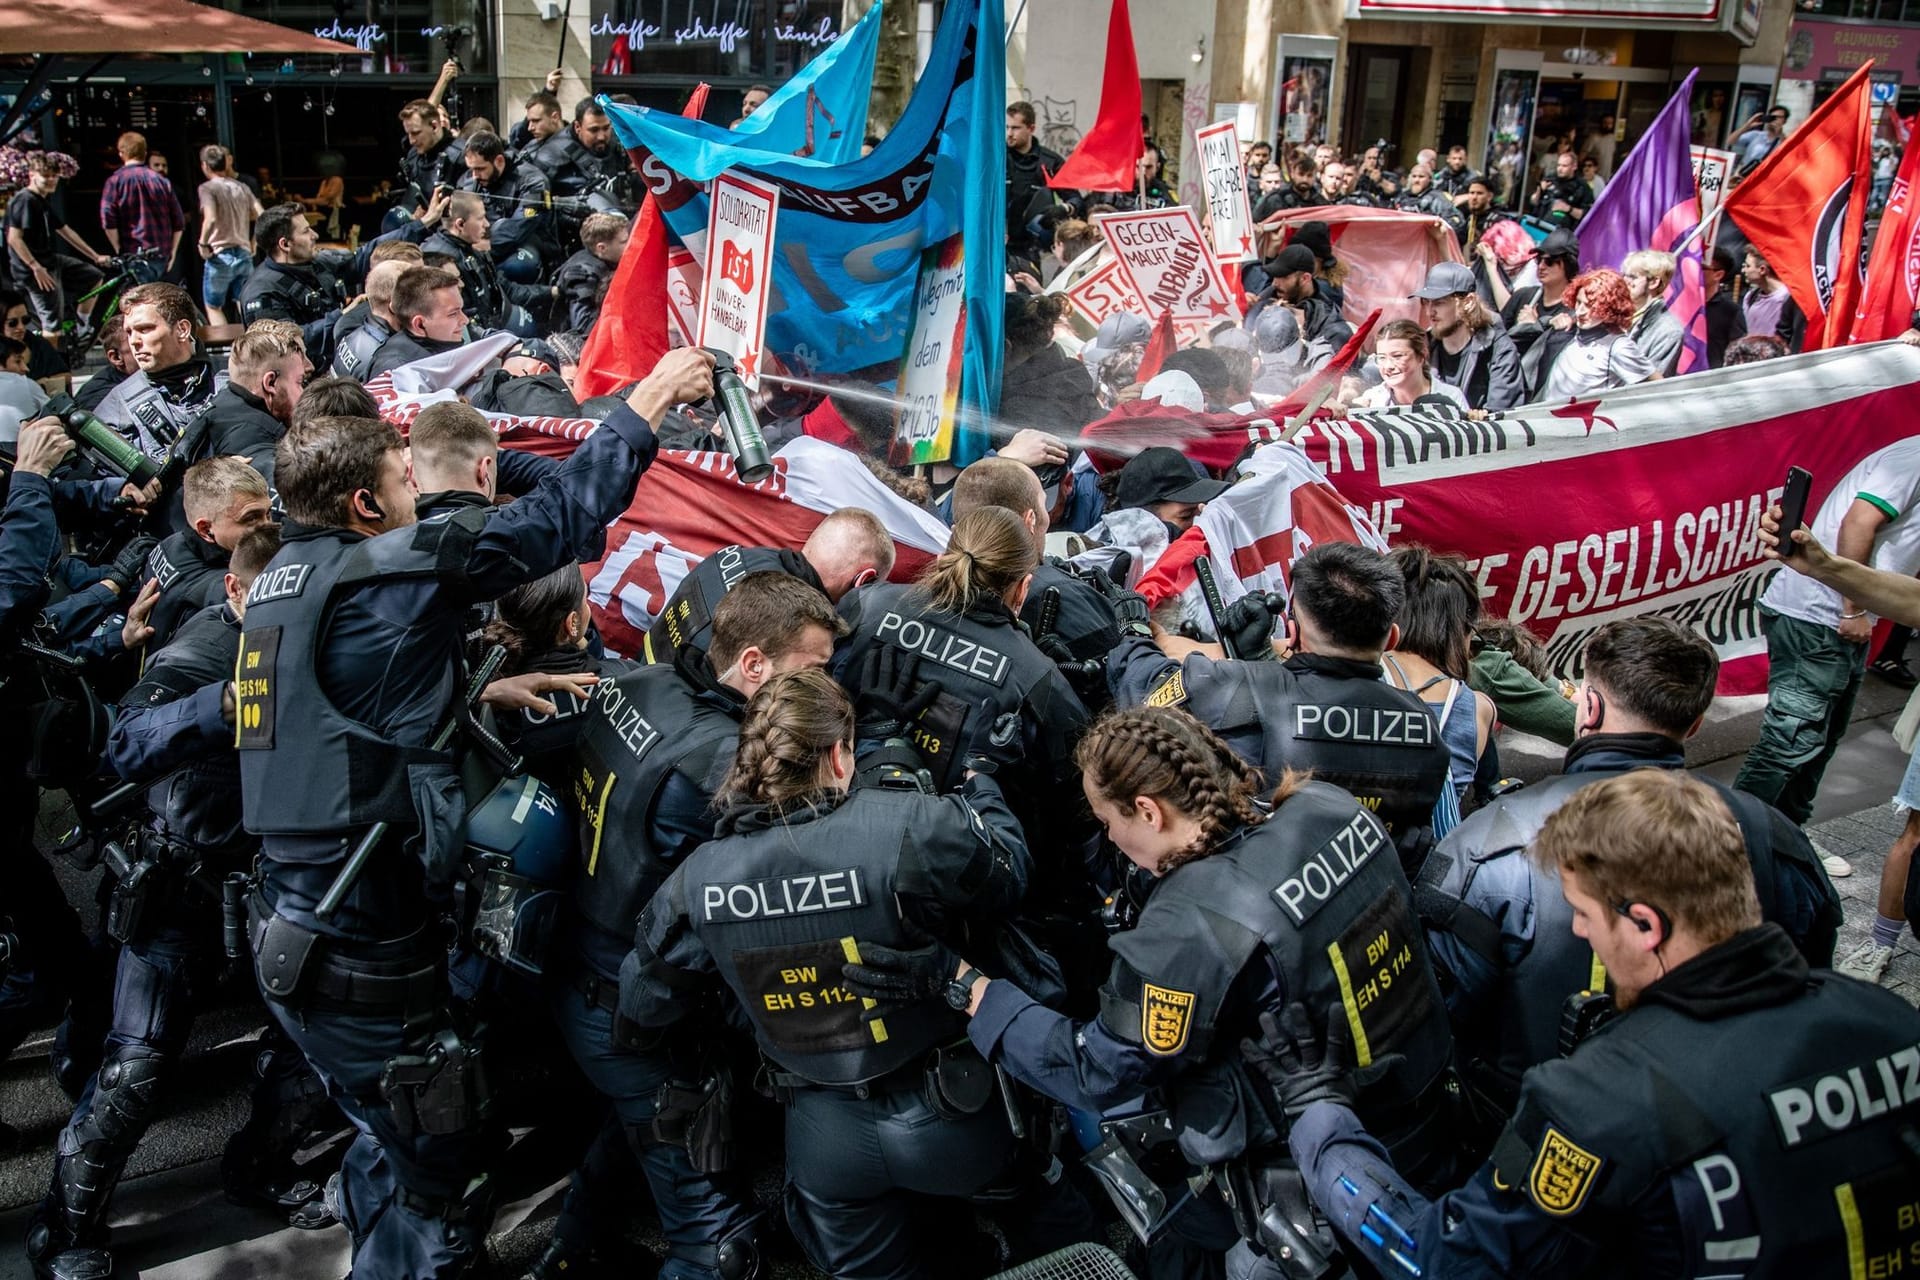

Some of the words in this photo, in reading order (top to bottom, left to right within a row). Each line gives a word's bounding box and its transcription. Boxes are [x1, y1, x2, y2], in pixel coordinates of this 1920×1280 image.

[674, 17, 749, 53] schaffe
[1115, 221, 1180, 247] GEGEN-
[1124, 246, 1173, 269] MACHT
[1148, 236, 1200, 314] AUFBAUEN
[914, 328, 941, 368] dem
[1509, 486, 1784, 625] GESELLSCHAF
[247, 563, 309, 603] POLIZEI
[875, 611, 1008, 682] POLIZEI
[596, 677, 657, 756] POLIZEI
[1297, 704, 1432, 744] POLIZEI
[914, 729, 941, 754] 113
[1275, 809, 1384, 920] POLIZEI
[704, 870, 862, 920] POLIZEI
[1366, 930, 1390, 967] BW
[781, 966, 817, 984] BW
[1357, 978, 1380, 1011] EH
[1378, 967, 1392, 990] S
[1392, 944, 1412, 976] 114
[763, 993, 795, 1011] EH
[798, 992, 815, 1007] S
[1148, 988, 1188, 1006] POLIZEI
[1770, 1042, 1920, 1146] POLIZ
[1548, 1137, 1592, 1171] POLIZEI
